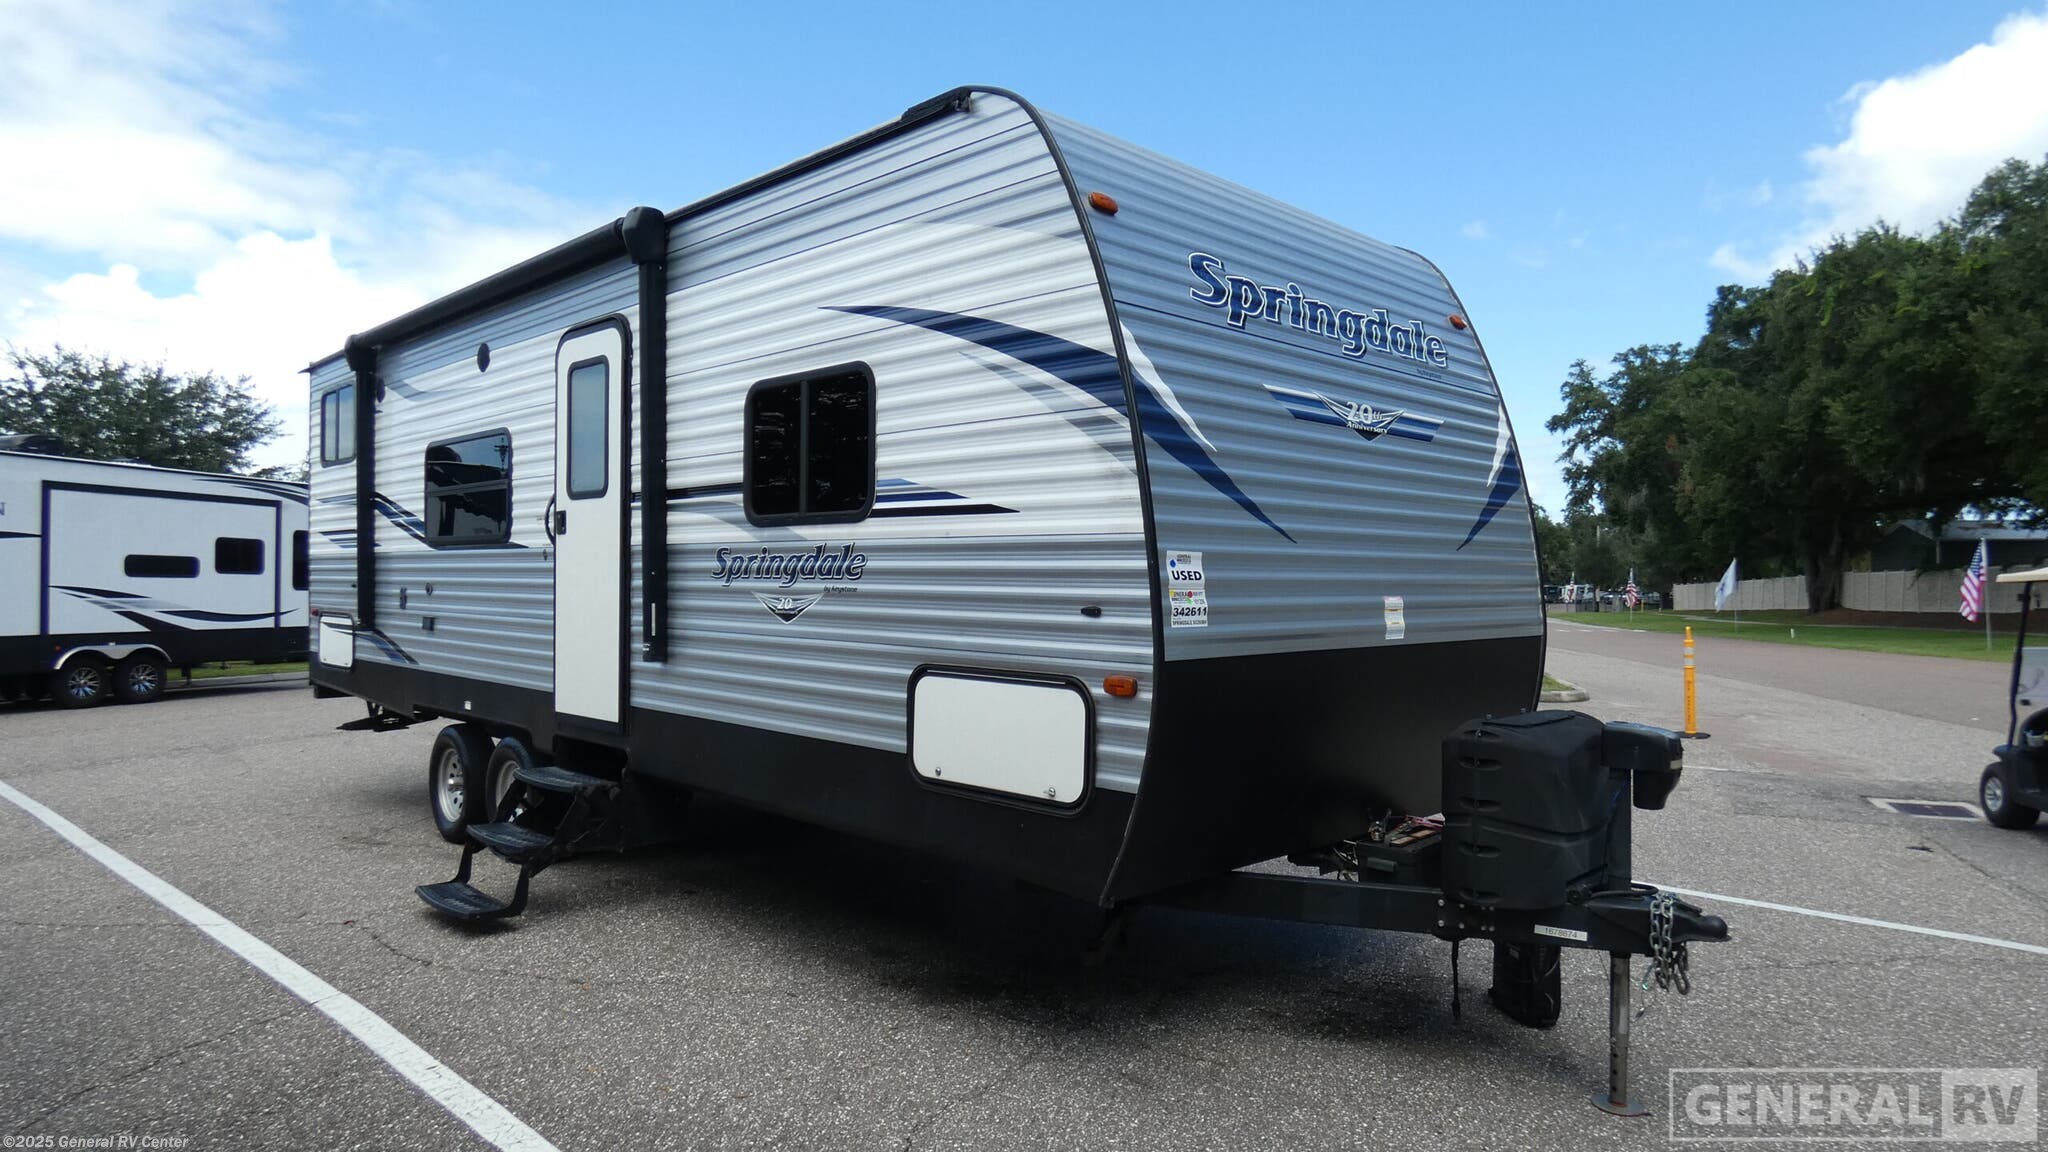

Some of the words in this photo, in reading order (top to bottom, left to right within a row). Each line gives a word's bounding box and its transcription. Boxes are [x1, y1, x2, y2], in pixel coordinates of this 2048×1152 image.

[1188, 252, 1448, 368] Springdale
[711, 542, 868, 588] Springdale
[1171, 570, 1202, 581] USED
[777, 597, 792, 609] 20
[1173, 607, 1207, 617] 342611
